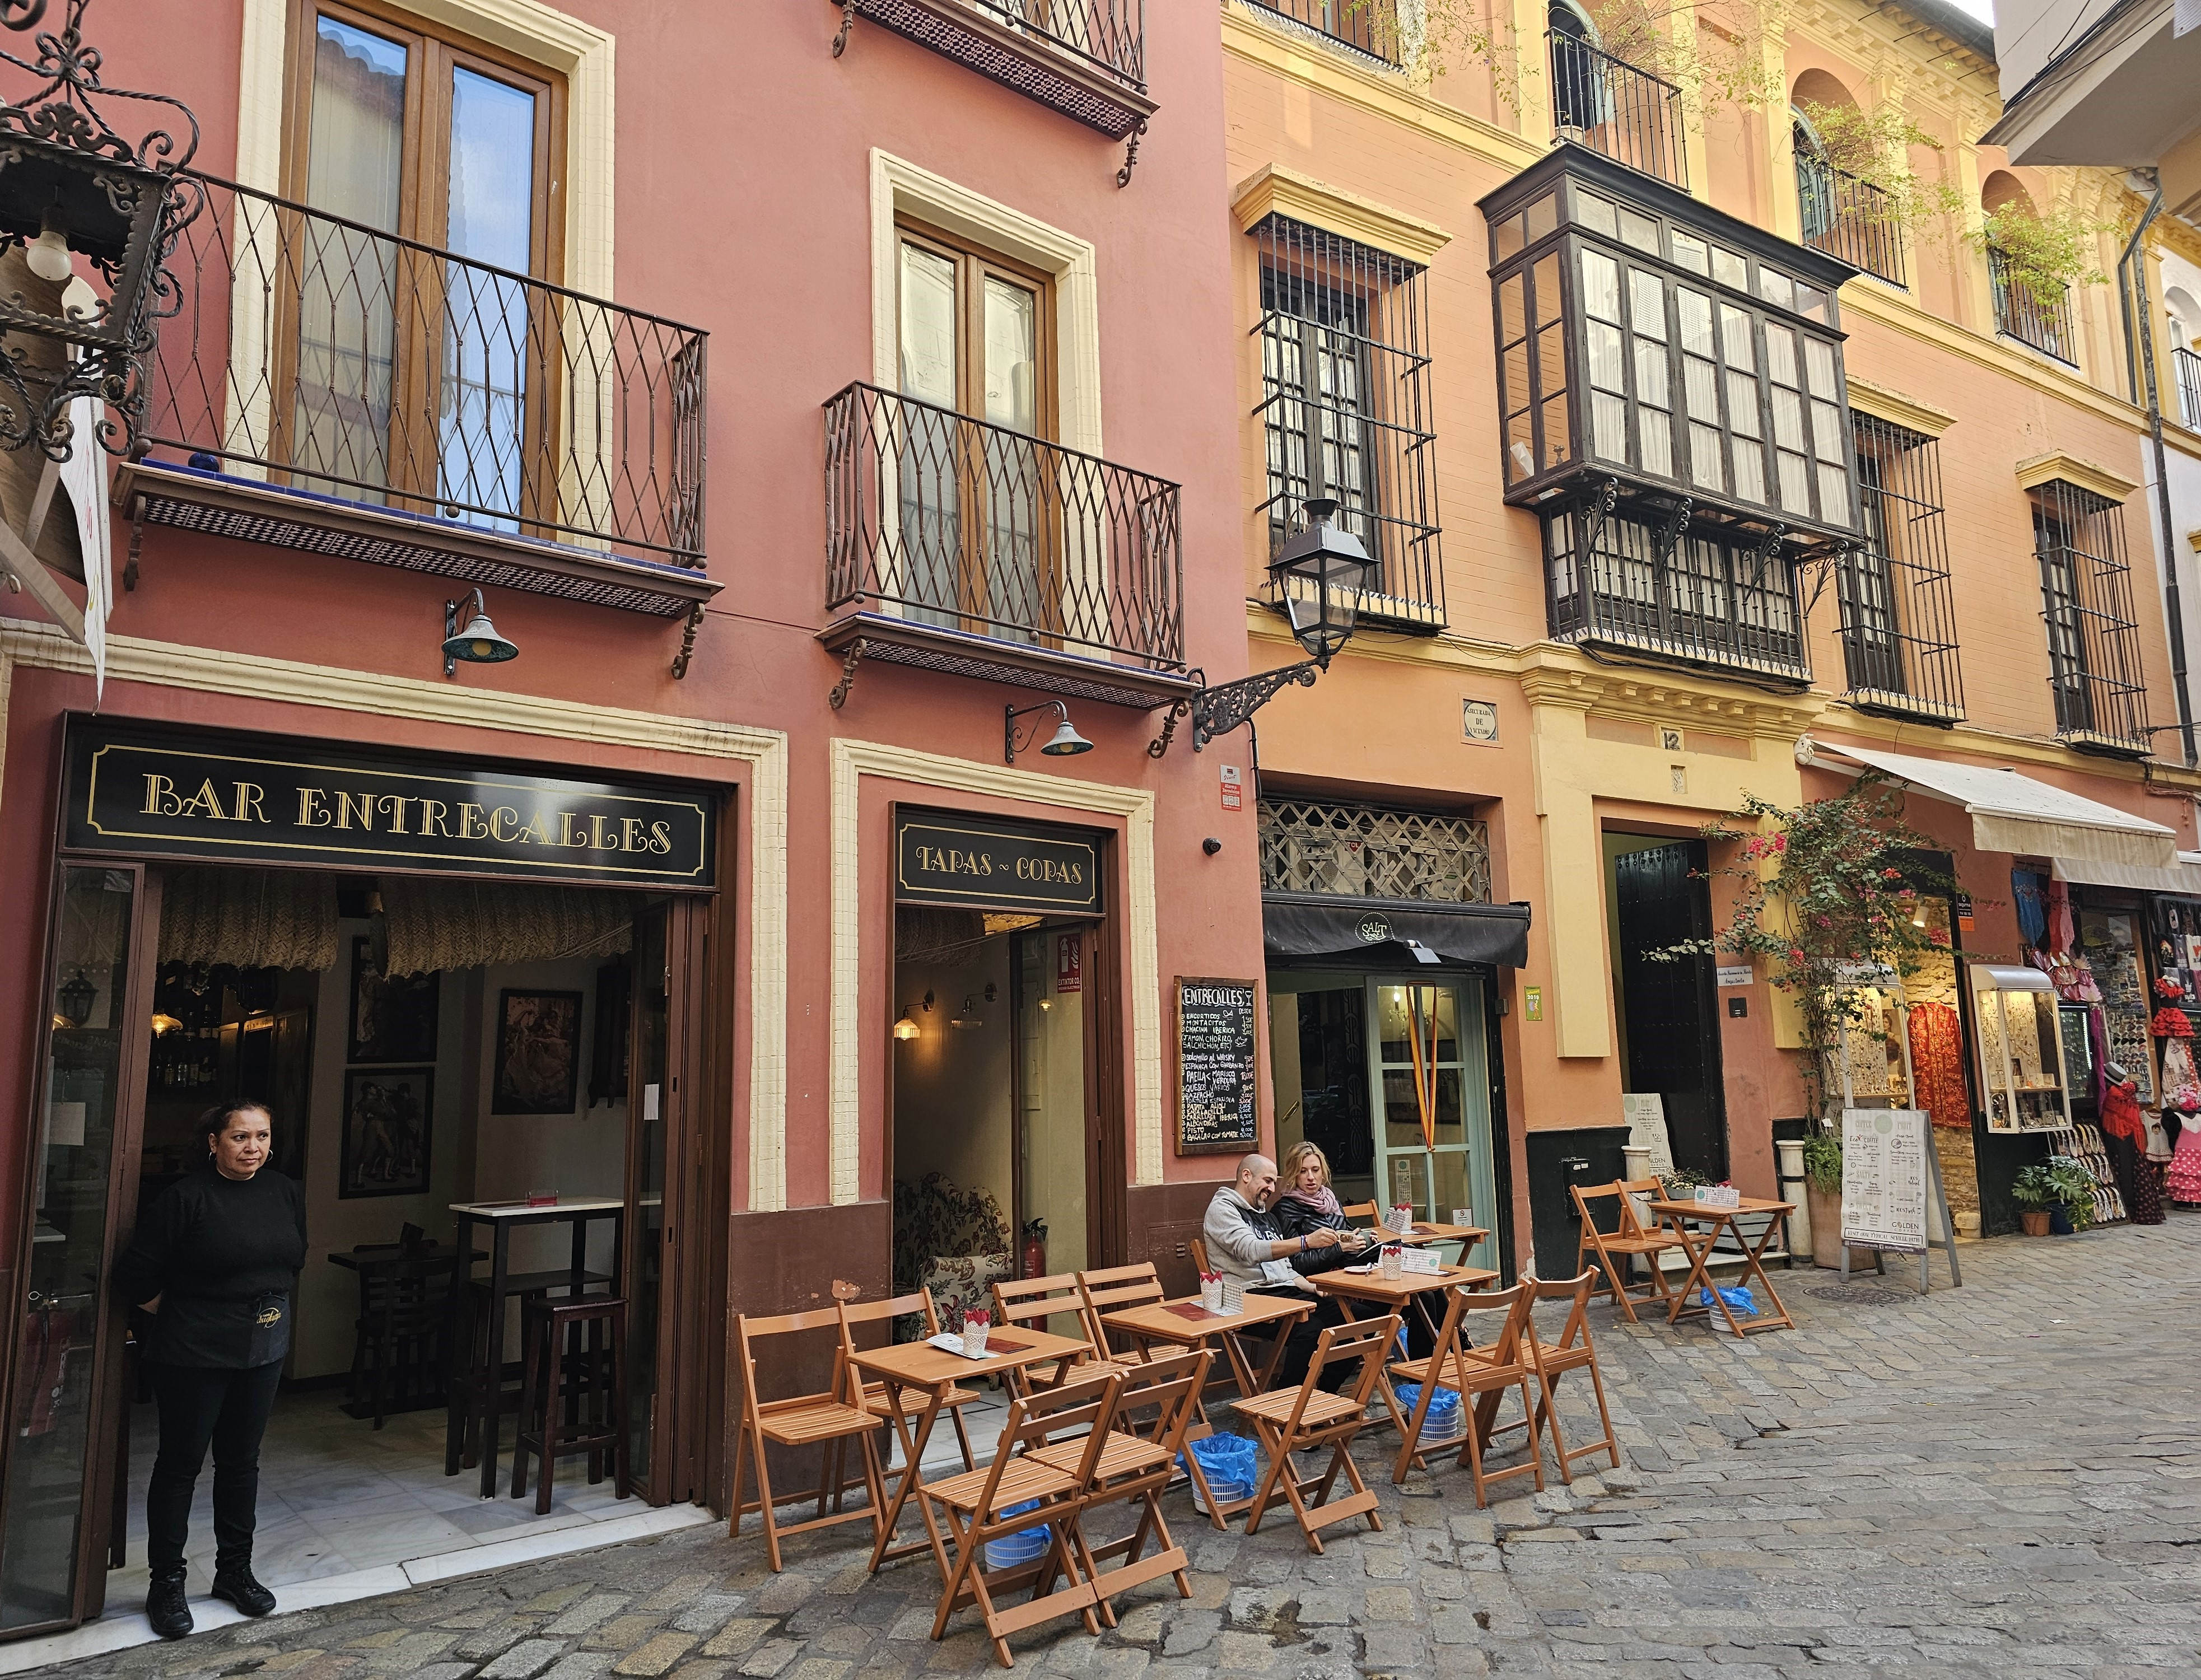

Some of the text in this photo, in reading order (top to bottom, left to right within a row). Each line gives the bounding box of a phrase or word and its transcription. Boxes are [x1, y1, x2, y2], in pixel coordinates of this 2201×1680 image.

[139, 773, 673, 855] BAR ENTRECALLES
[916, 846, 1082, 884] TAPAS COPAS
[1361, 922, 1387, 938] SALT
[1184, 988, 1243, 1005] ENTRECALLES
[1187, 1071, 1206, 1084] PAELLA
[1185, 1084, 1206, 1093] QUESOS
